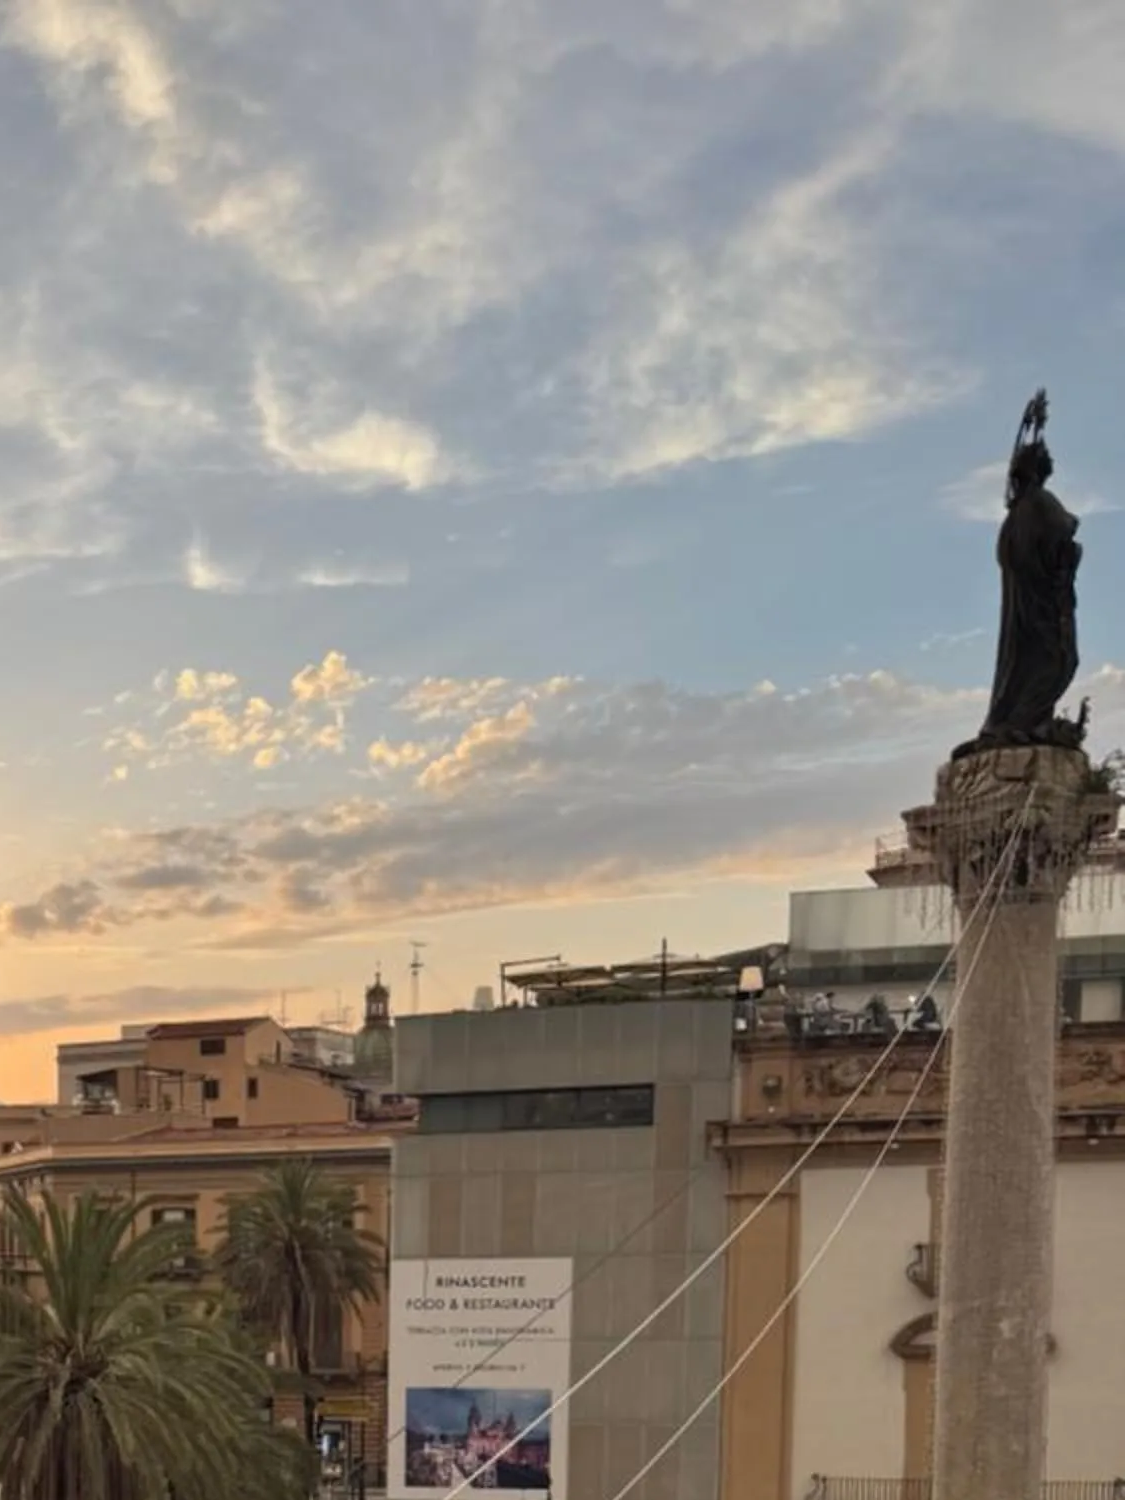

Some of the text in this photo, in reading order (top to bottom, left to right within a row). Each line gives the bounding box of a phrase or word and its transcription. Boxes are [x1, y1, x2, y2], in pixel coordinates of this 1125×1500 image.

[435, 1275, 526, 1288] RINASCENTE
[406, 1298, 445, 1311] FOOD
[449, 1298, 458, 1310] &
